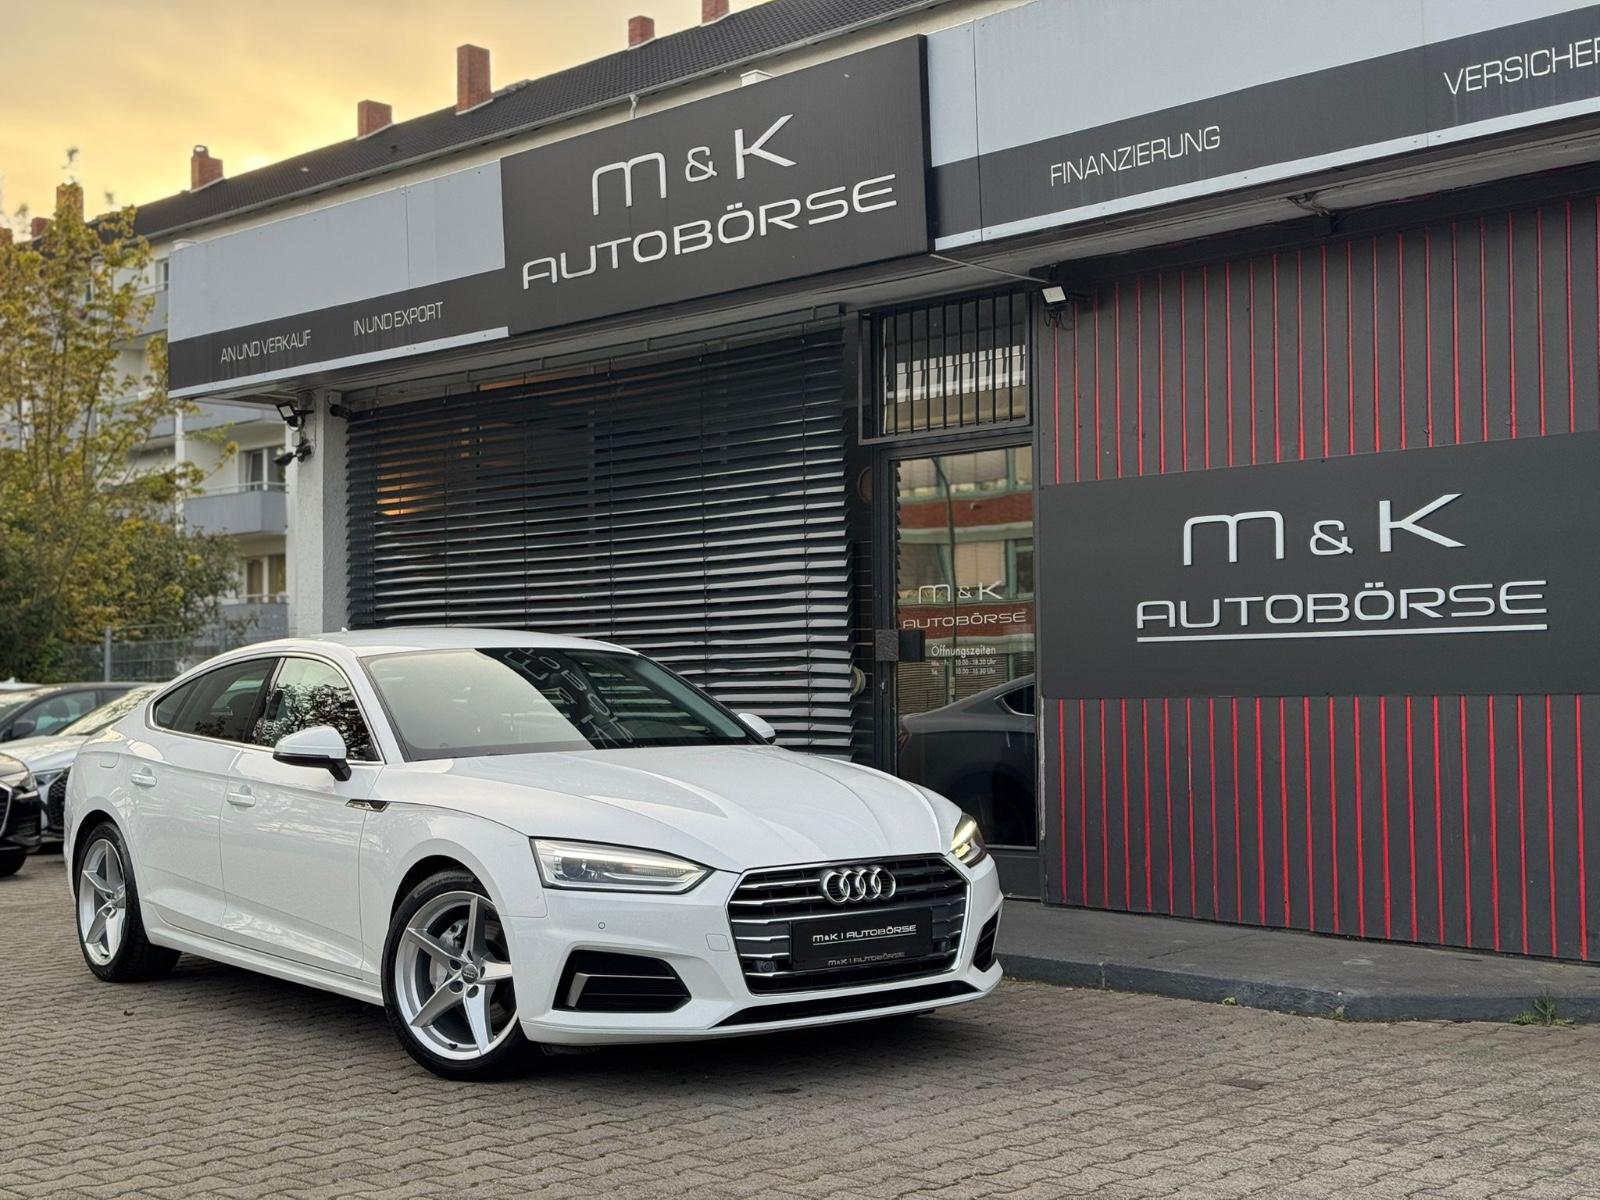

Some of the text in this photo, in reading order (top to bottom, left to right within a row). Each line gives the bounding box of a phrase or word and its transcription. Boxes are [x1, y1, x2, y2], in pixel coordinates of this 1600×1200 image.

[592, 113, 798, 216] M & K
[1050, 125, 1221, 187] FINANZIERUNG
[522, 173, 897, 290] AUTOBÖRSE
[353, 301, 444, 336] IN UND EXPORT
[220, 329, 312, 364] AN UND VERKAUF
[1183, 493, 1466, 566] M & K
[919, 580, 1004, 604] M & K
[1137, 580, 1547, 629] AUTOBÖRSE
[903, 611, 1027, 629] AUTOBÖRSE
[931, 643, 997, 659] Öffnungszeiten
[846, 924, 917, 939] AUTOBÖRSE
[853, 951, 905, 963] AUTOBÖRSE
